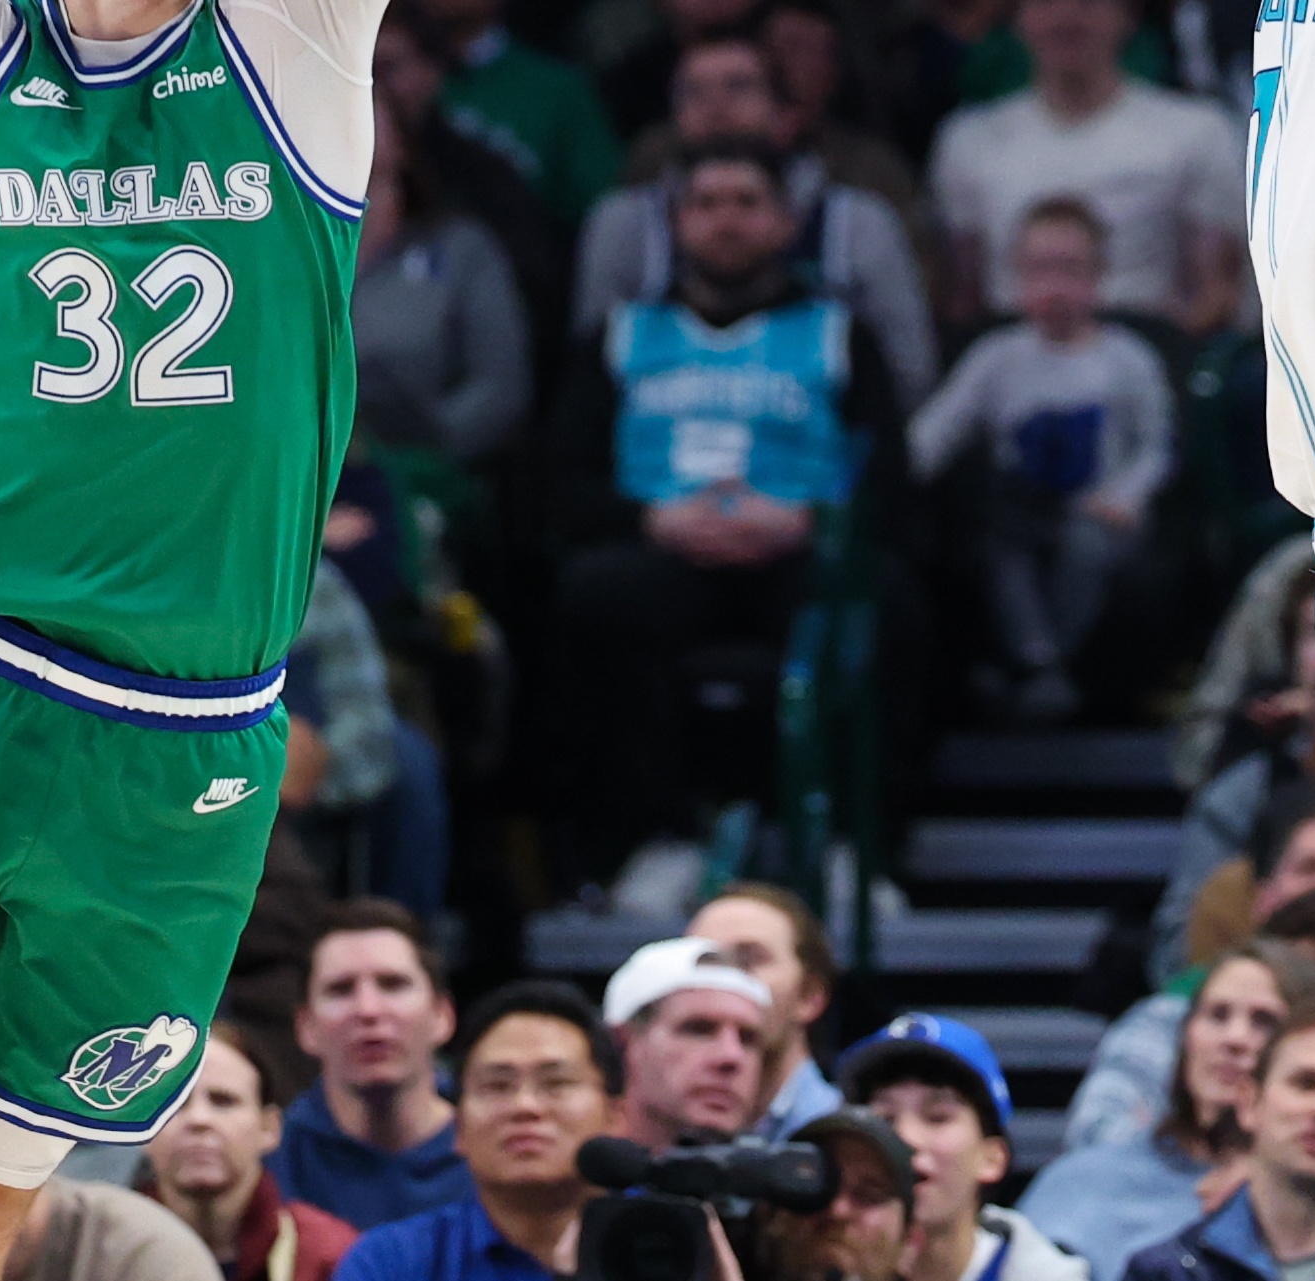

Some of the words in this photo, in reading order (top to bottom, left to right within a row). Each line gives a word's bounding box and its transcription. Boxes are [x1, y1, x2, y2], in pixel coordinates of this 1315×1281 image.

[22, 76, 69, 104] NIKE
[152, 65, 227, 99] chime
[28, 244, 234, 407] 32
[204, 777, 248, 801] NIKE
